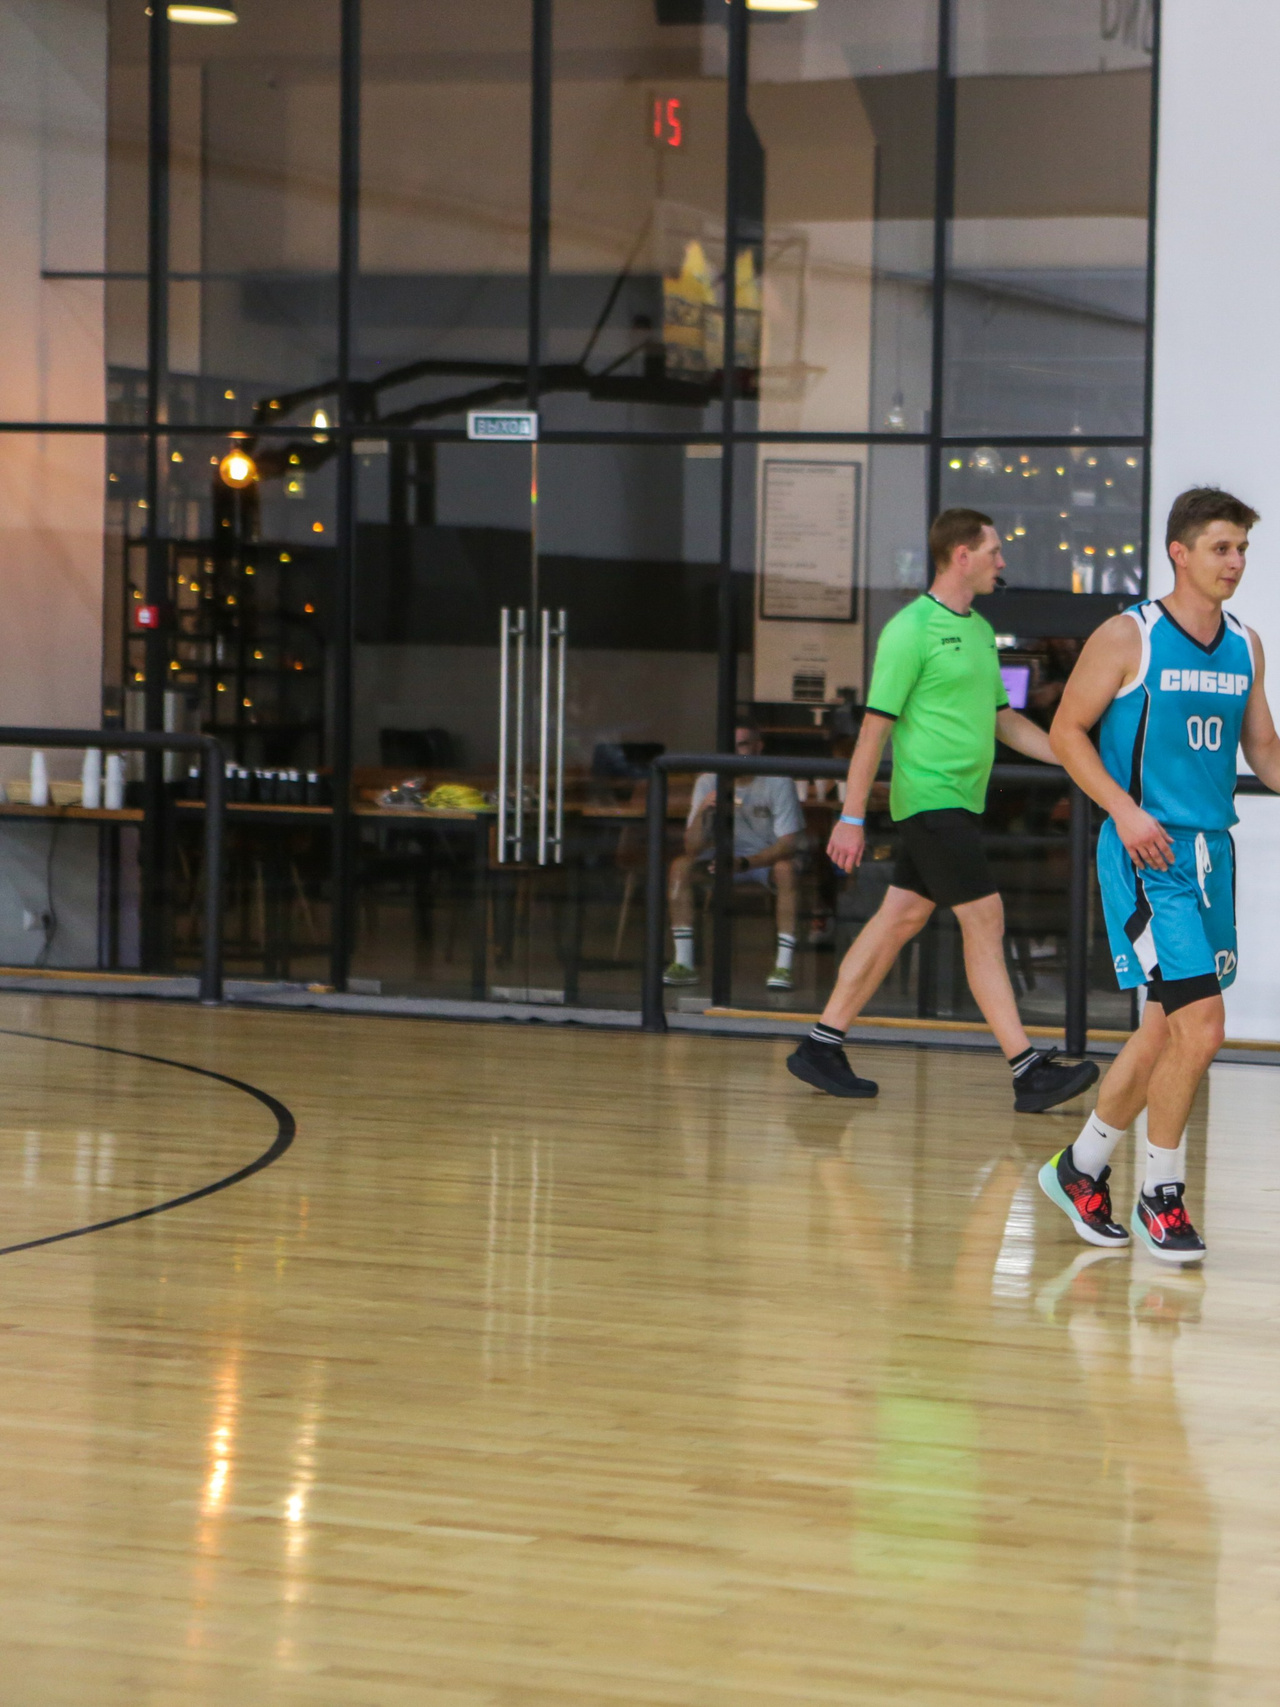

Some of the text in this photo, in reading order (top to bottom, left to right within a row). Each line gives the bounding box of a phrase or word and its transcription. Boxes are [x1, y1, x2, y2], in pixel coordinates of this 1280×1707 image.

[653, 98, 682, 147] 15
[1160, 669, 1249, 696] СИБУР
[1186, 715, 1223, 752] 00
